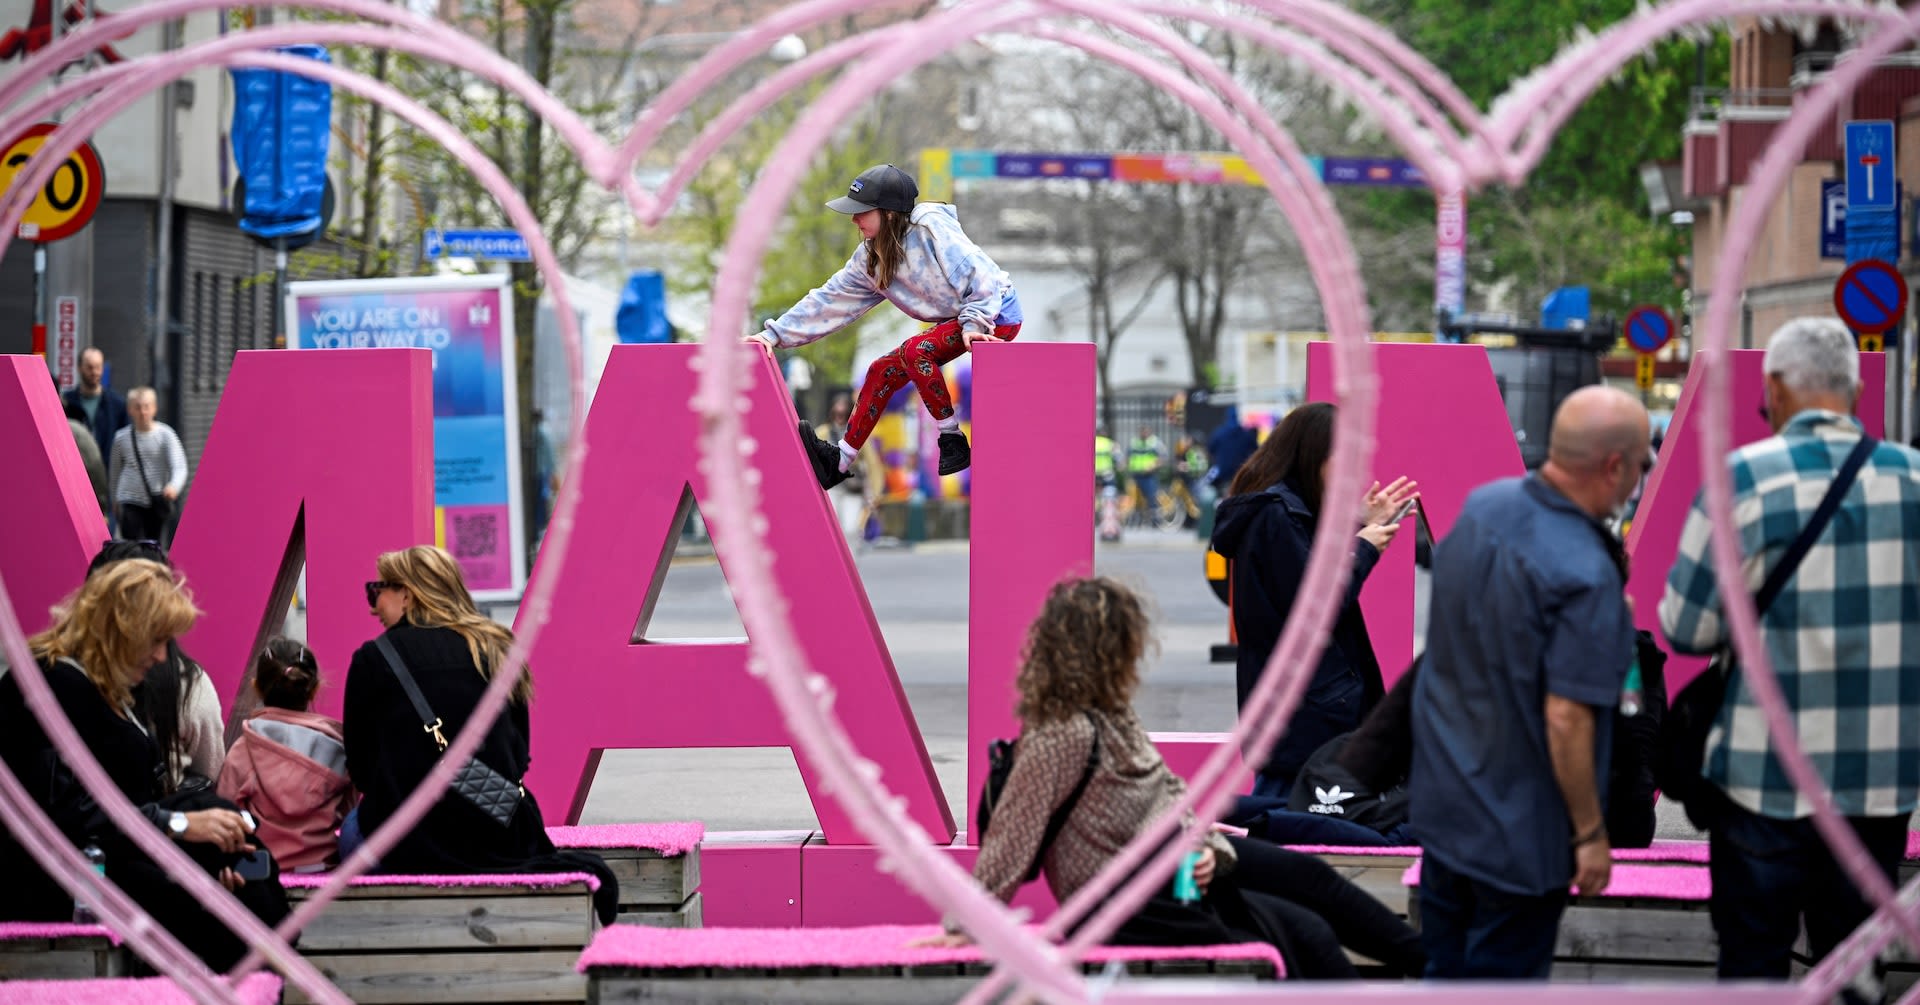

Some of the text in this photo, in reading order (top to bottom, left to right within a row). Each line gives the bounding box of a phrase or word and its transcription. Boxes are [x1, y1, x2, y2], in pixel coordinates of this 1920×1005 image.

[312, 306, 440, 331] YOU ARE ON
[313, 327, 450, 350] YOUR WAY TO
